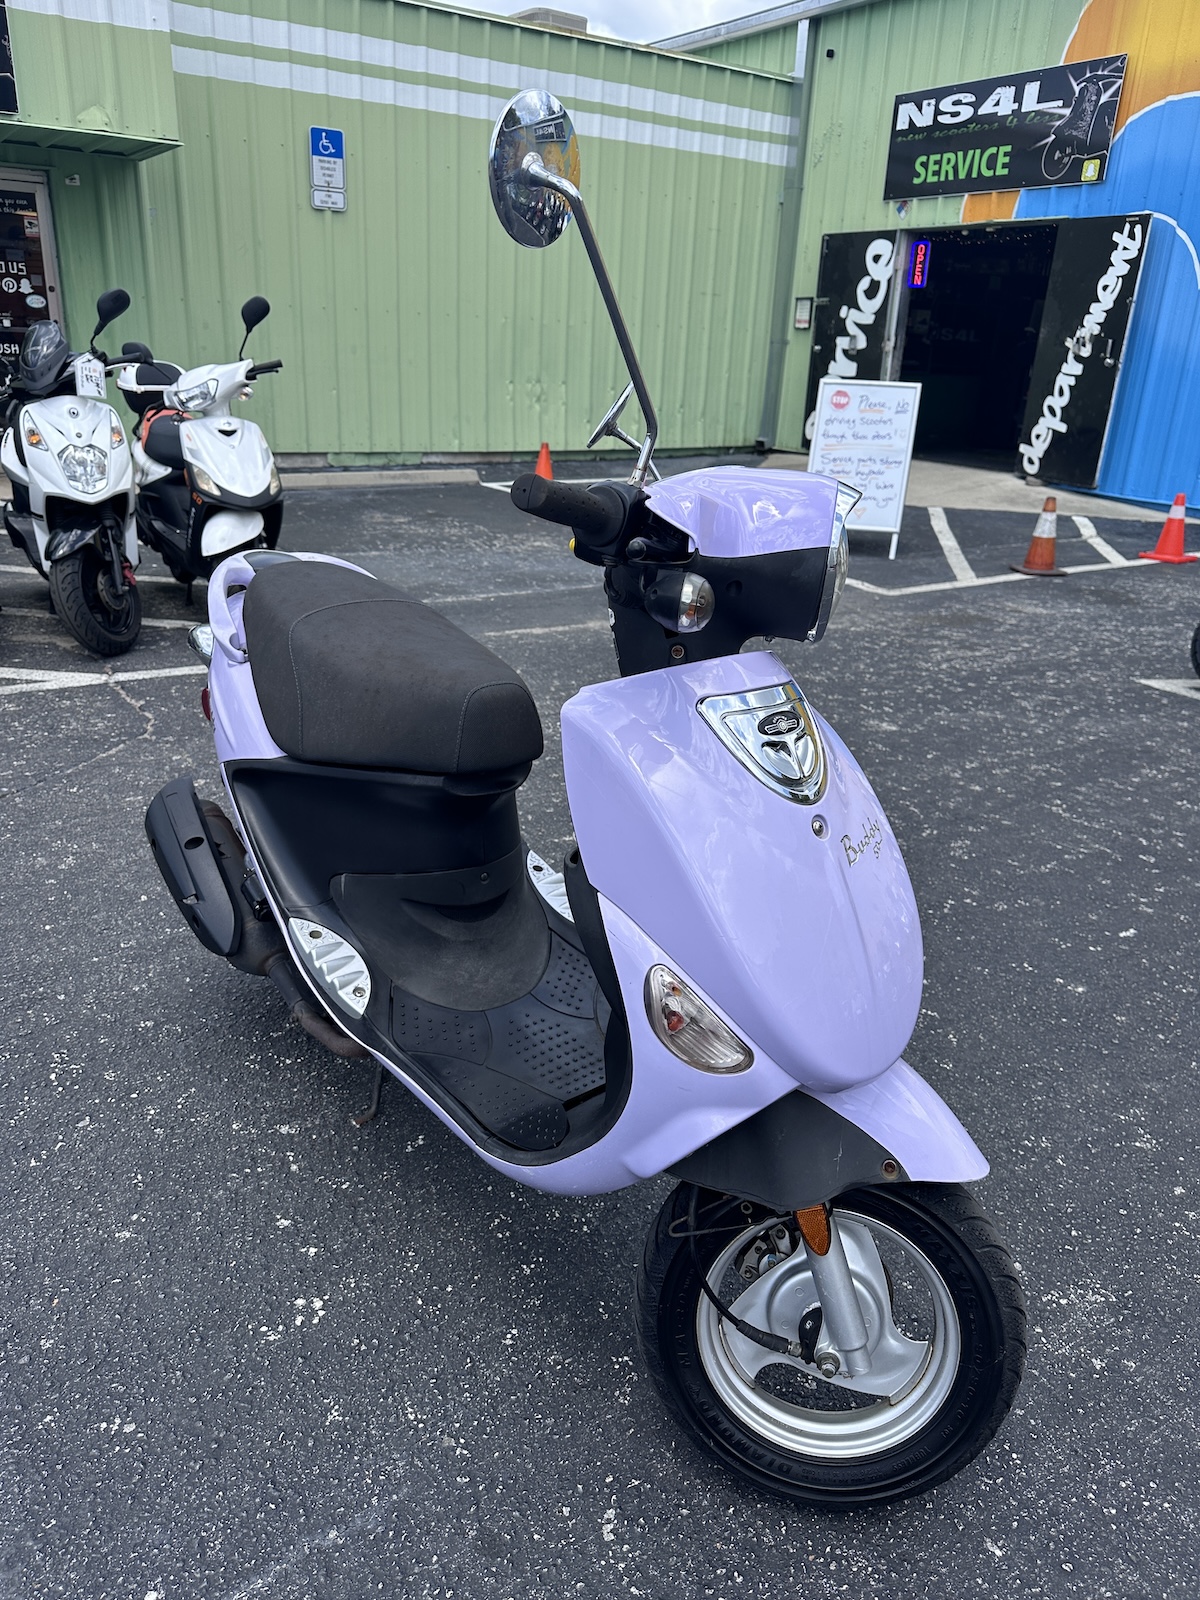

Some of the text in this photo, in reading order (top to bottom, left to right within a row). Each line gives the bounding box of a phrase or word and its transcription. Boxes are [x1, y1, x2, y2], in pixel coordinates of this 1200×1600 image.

[896, 80, 1064, 131] NS4L
[895, 111, 1062, 144] new scooters 4 less
[912, 144, 1013, 185] SERVICE
[8, 261, 27, 275] US
[913, 244, 926, 285] OPEN
[840, 816, 883, 867] Buddy
[693, 1396, 794, 1475] DIAMOND
